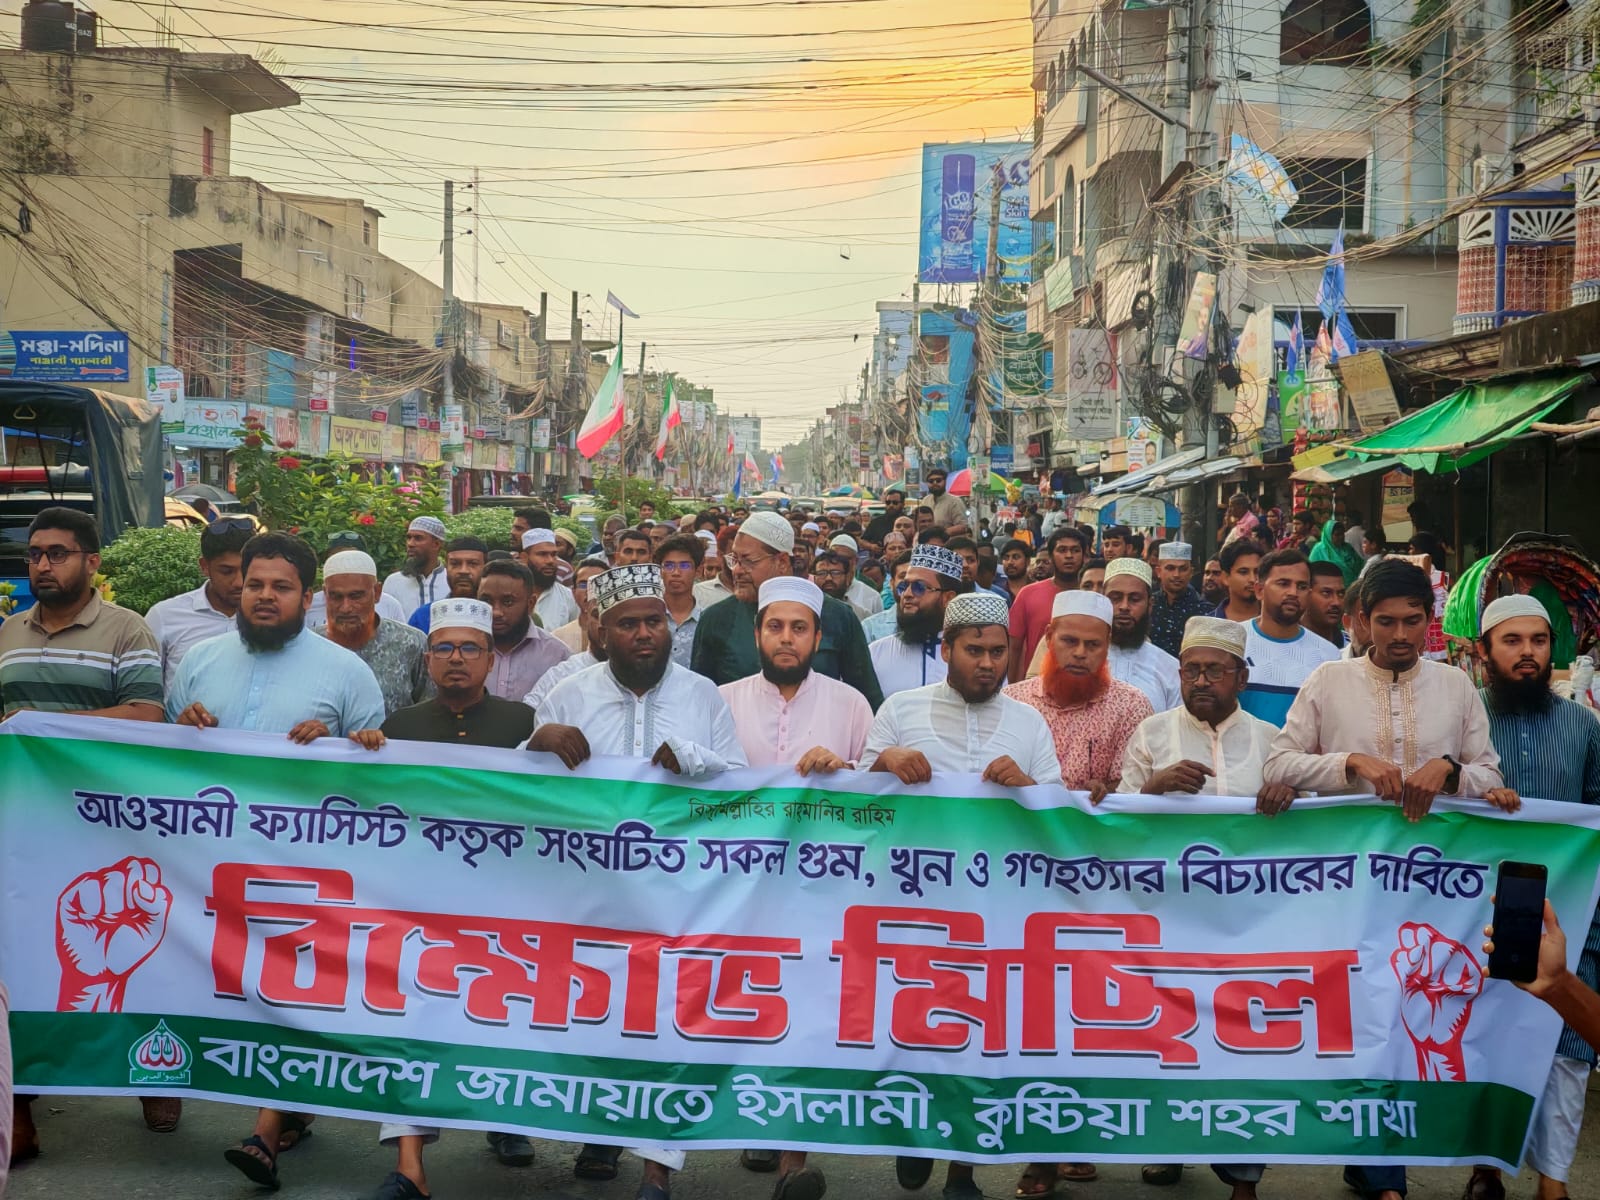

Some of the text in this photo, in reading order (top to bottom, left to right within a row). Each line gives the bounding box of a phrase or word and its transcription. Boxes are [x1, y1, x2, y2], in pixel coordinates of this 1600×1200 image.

[20, 333, 125, 355] মক্কা-মদিনা
[75, 786, 1489, 899] আওয়ামী ফ্যাসিস্ট কতৃক সংঘটিত সকল গুম, খুন ও গণহত্যার বিচ্যারের দাবিতে
[851, 803, 896, 827] রাহিম
[204, 864, 1361, 1068] বিক্ষোভ মিছিল
[200, 1036, 1417, 1149] বাংলাদেশ জামায়াতে ইসলামী, কুষ্টিয়া শহর শাখা
